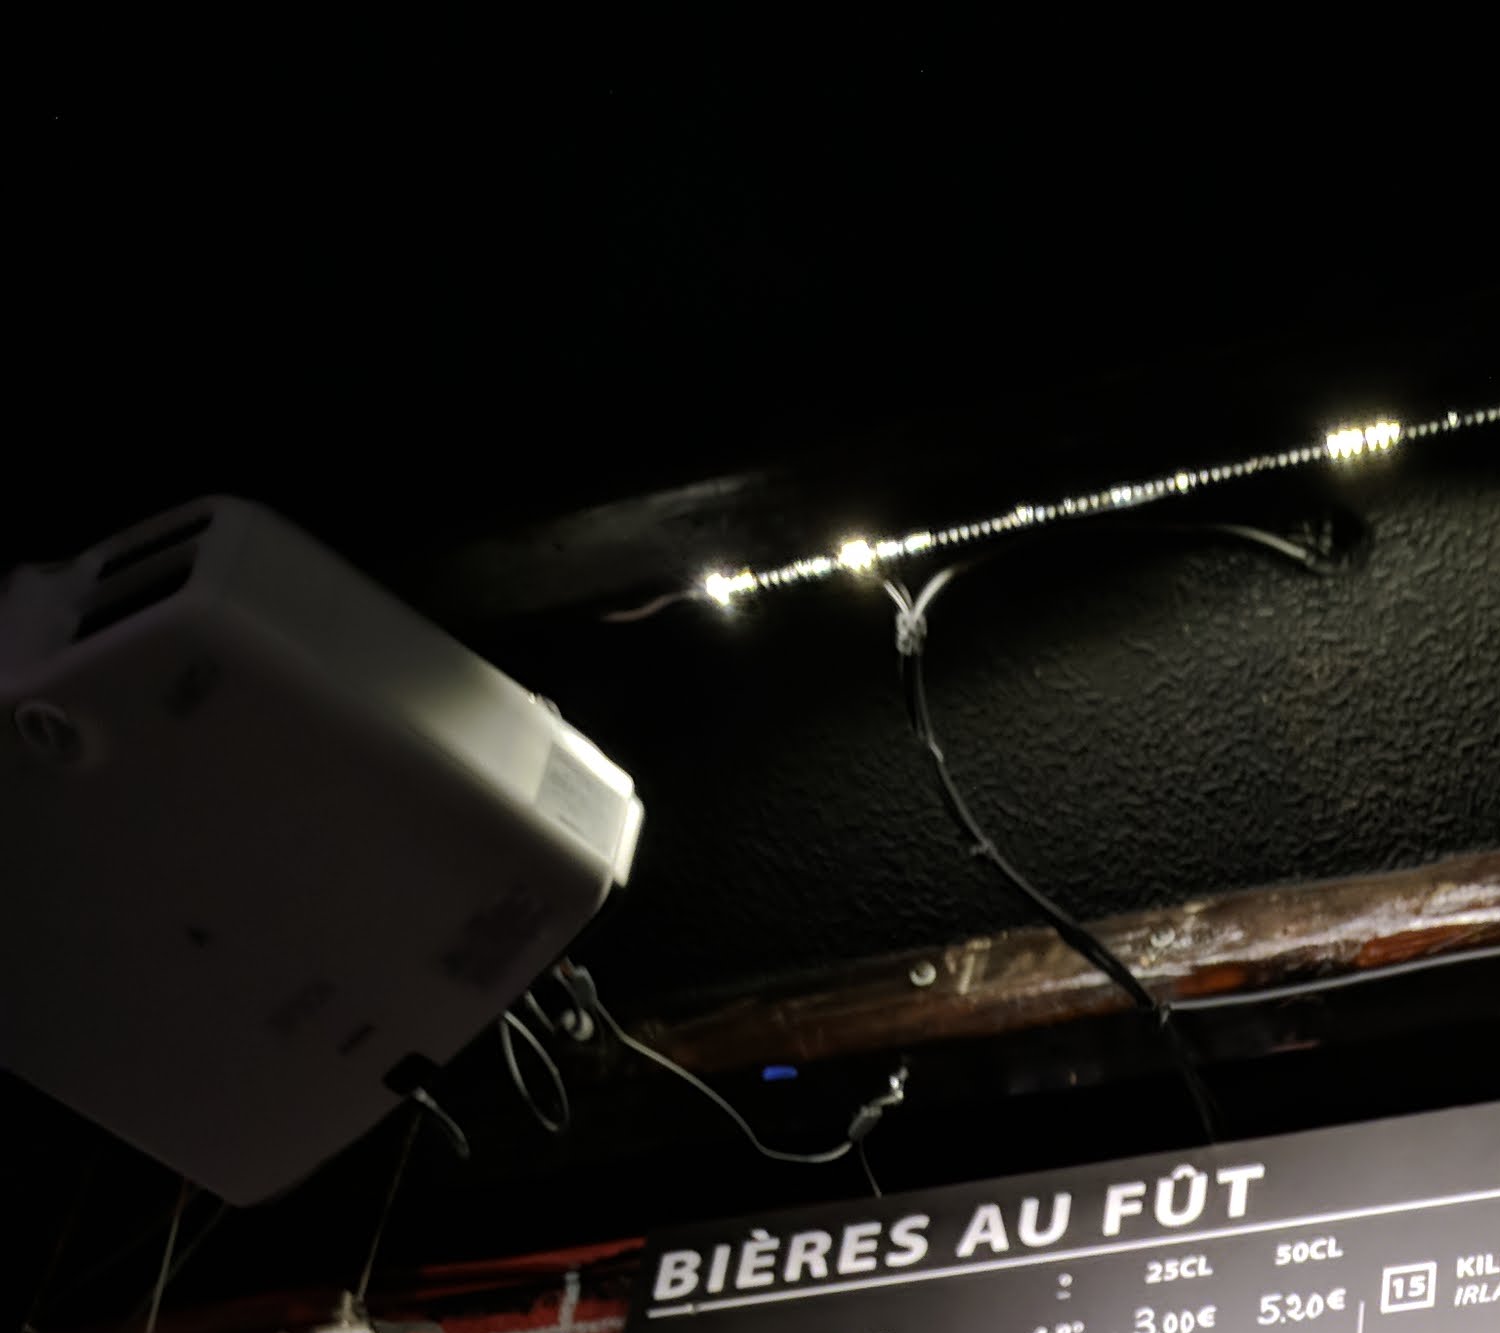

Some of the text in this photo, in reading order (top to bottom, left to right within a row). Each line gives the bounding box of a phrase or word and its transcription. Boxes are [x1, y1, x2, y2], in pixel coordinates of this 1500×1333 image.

[652, 1162, 1267, 1302] BIÈRES AU FÛT
[1144, 1235, 1345, 1285] 25CL 50CL
